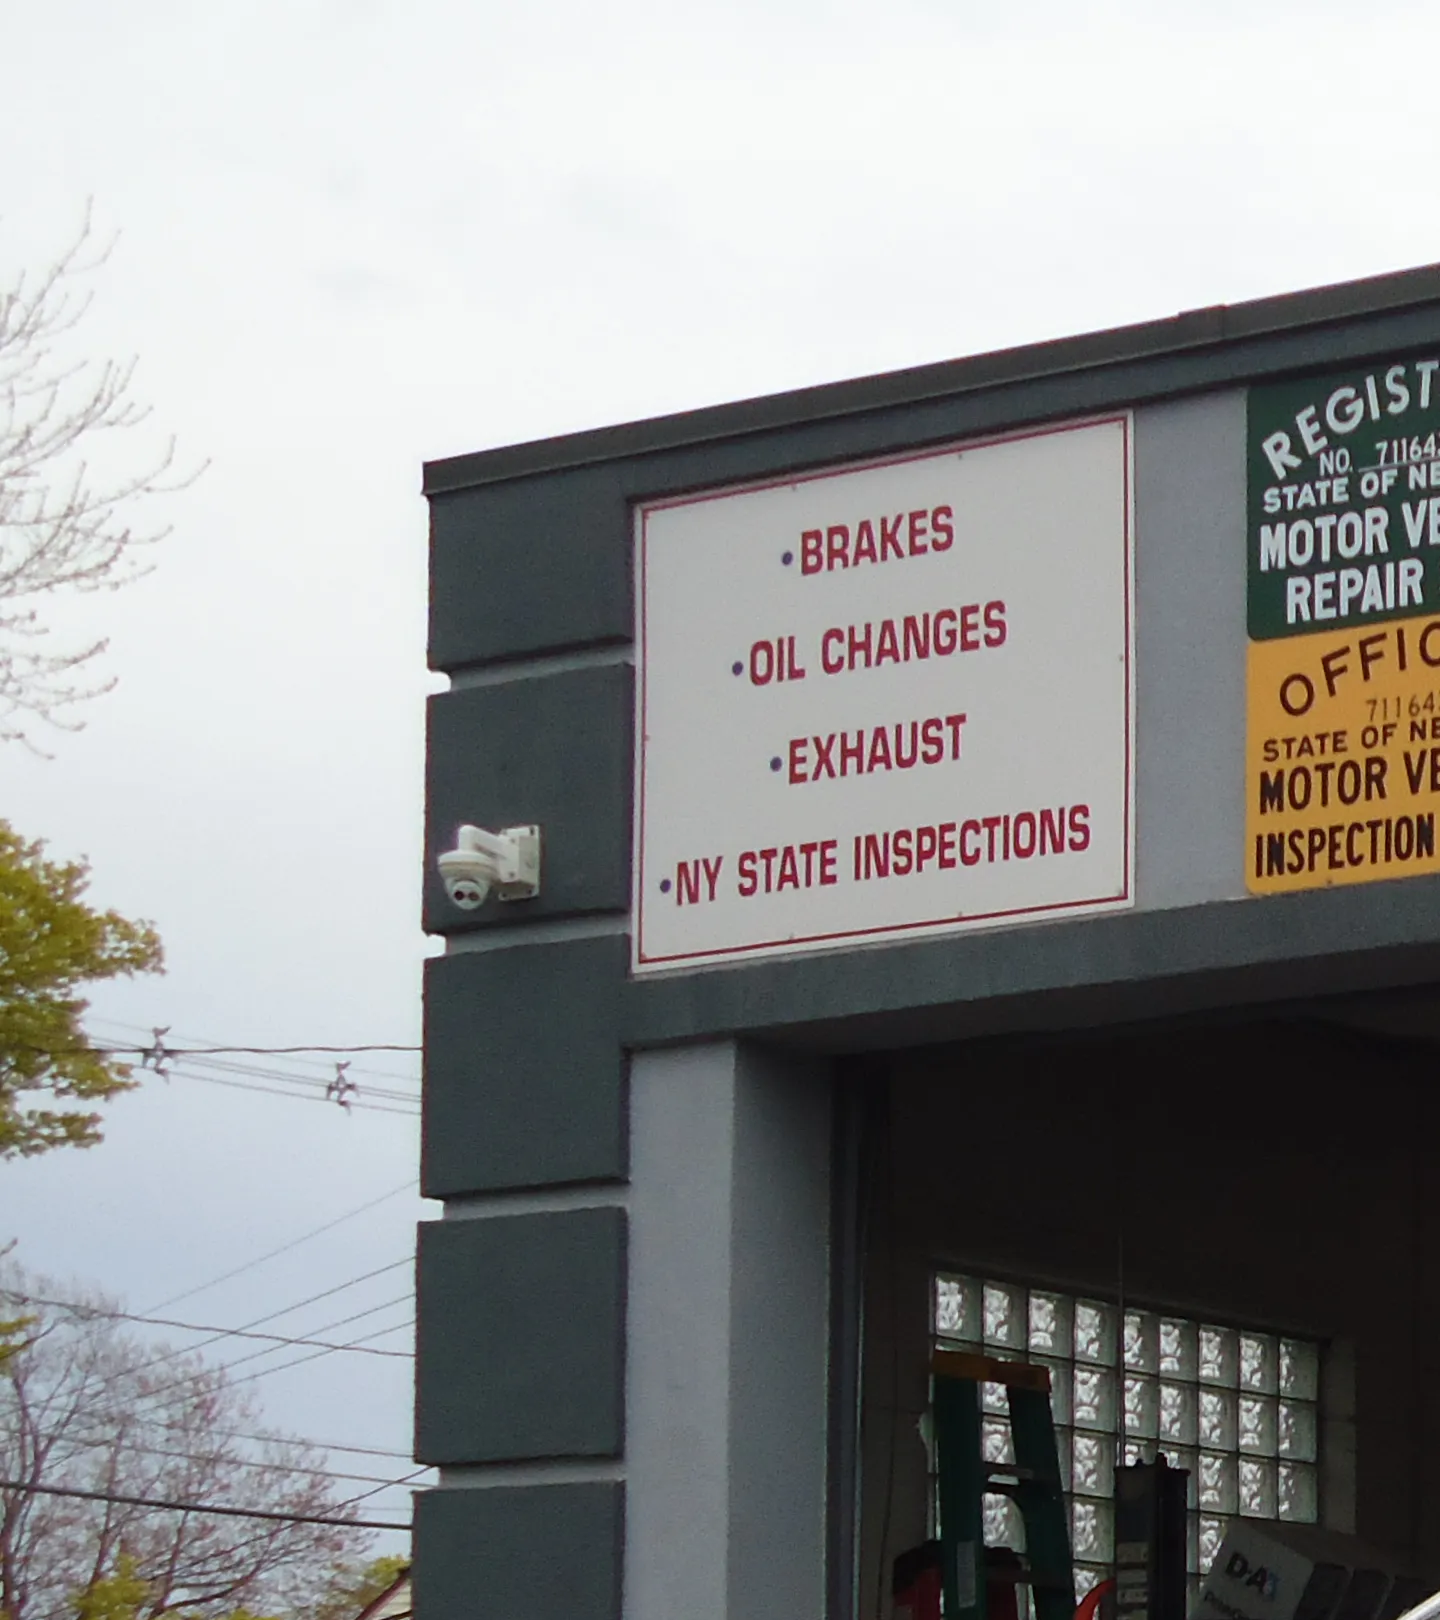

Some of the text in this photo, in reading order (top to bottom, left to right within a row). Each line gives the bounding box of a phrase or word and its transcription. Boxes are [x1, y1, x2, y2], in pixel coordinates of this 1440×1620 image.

[1263, 476, 1350, 514] STATE
[1361, 466, 1396, 498] OF
[1319, 449, 1353, 476] NO.
[800, 505, 954, 576] BRAKES
[1260, 506, 1390, 572] MOTOR
[1286, 557, 1424, 625] REPAIR
[749, 601, 1007, 685] OIL CHANGES
[788, 714, 967, 785] EXHAUST
[1263, 727, 1349, 762] STATE
[1361, 722, 1397, 749] OF
[1260, 754, 1389, 815] MOTOR
[676, 804, 1091, 907] NY STATE INSPECTIONS
[1255, 811, 1435, 879] INSPECTION
